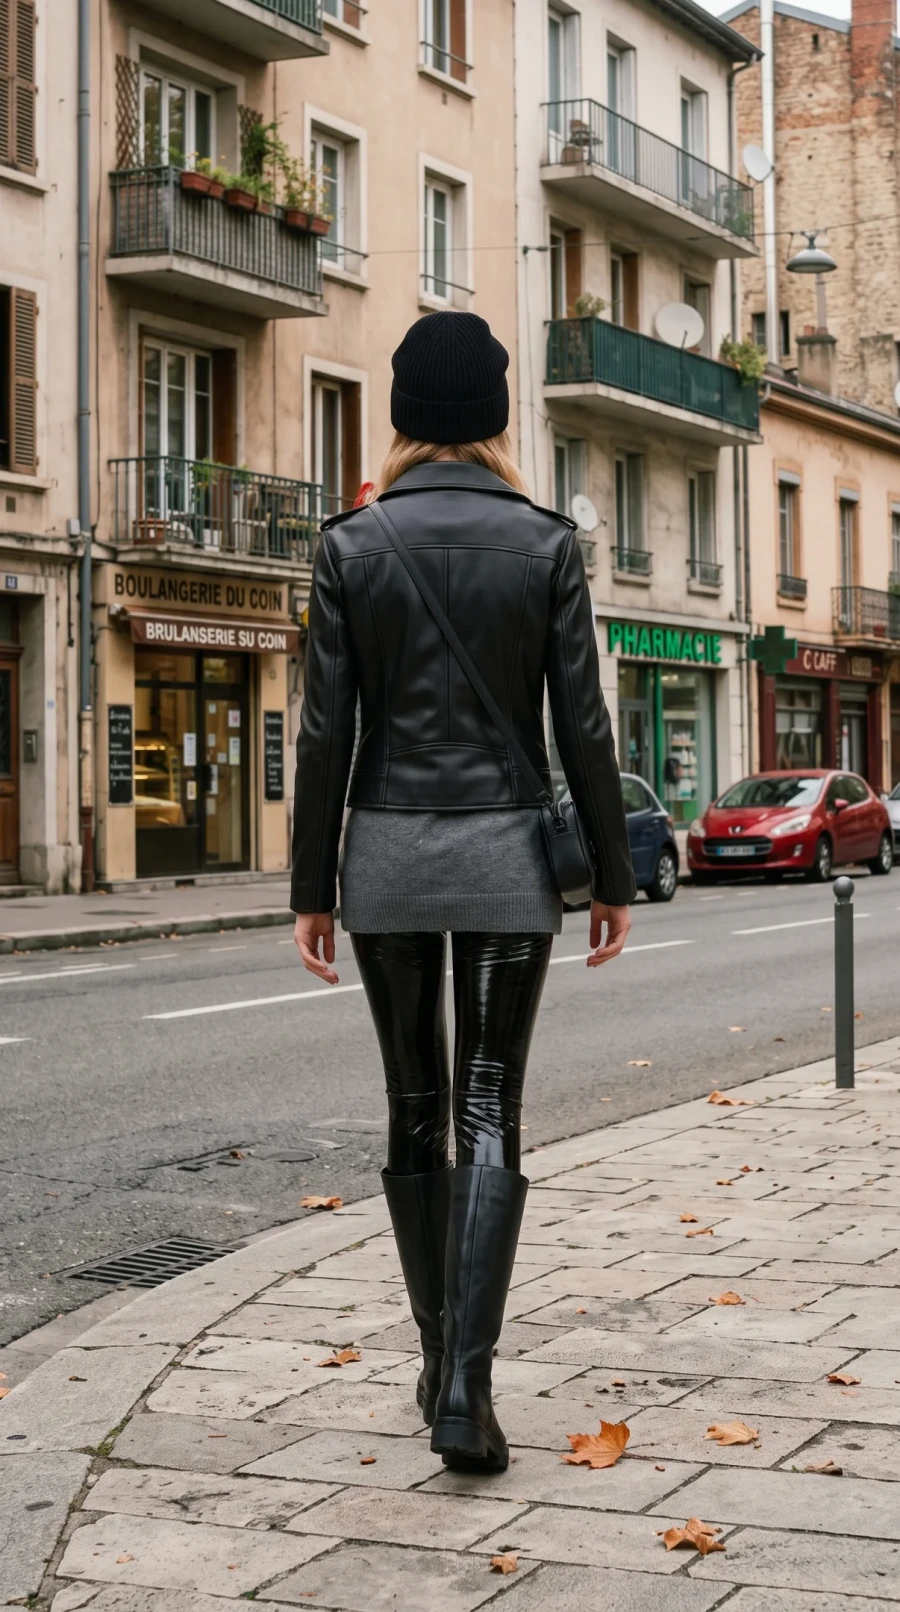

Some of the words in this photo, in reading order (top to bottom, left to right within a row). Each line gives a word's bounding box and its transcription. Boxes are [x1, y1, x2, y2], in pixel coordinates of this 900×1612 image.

[114, 573, 222, 606] BOULANGERIE
[226, 586, 246, 608] DU
[250, 588, 283, 612] COIN
[145, 622, 237, 647] BRULANSERIE
[238, 630, 255, 648] SU
[257, 632, 288, 650] COIN
[608, 622, 722, 664] PHARMACIE
